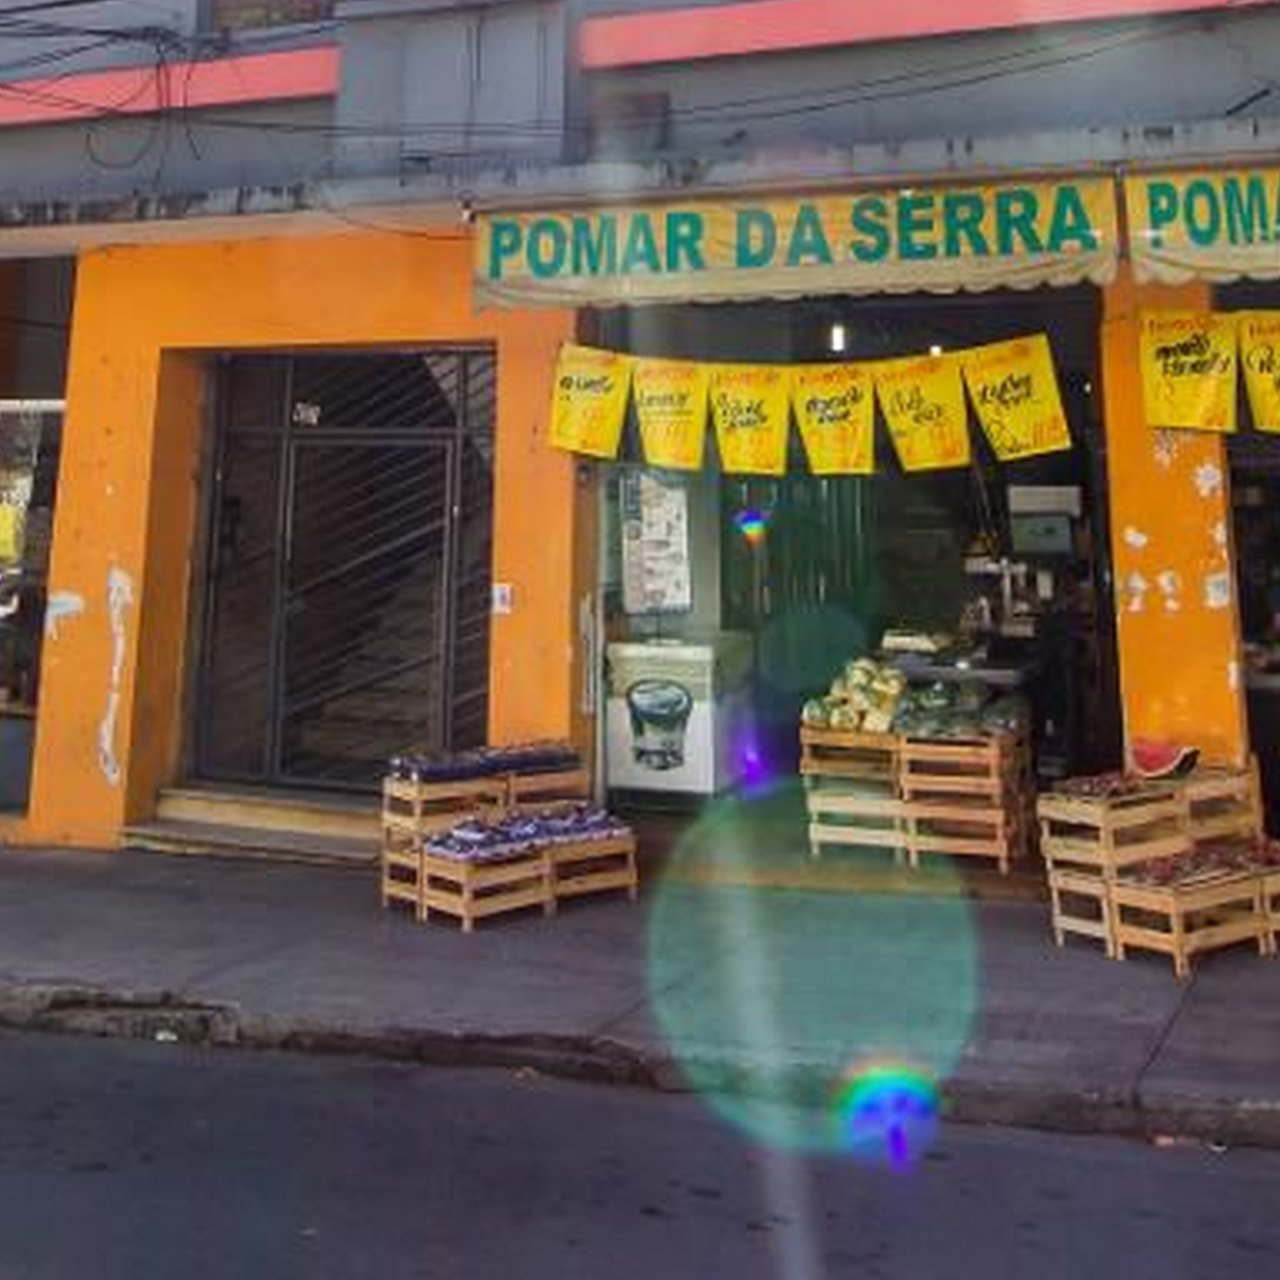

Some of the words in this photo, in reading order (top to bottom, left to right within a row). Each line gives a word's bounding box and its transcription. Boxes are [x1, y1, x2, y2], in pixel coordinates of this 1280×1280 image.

[489, 211, 706, 280] POMAR
[735, 201, 834, 268] DA
[850, 185, 1098, 262] SERRA
